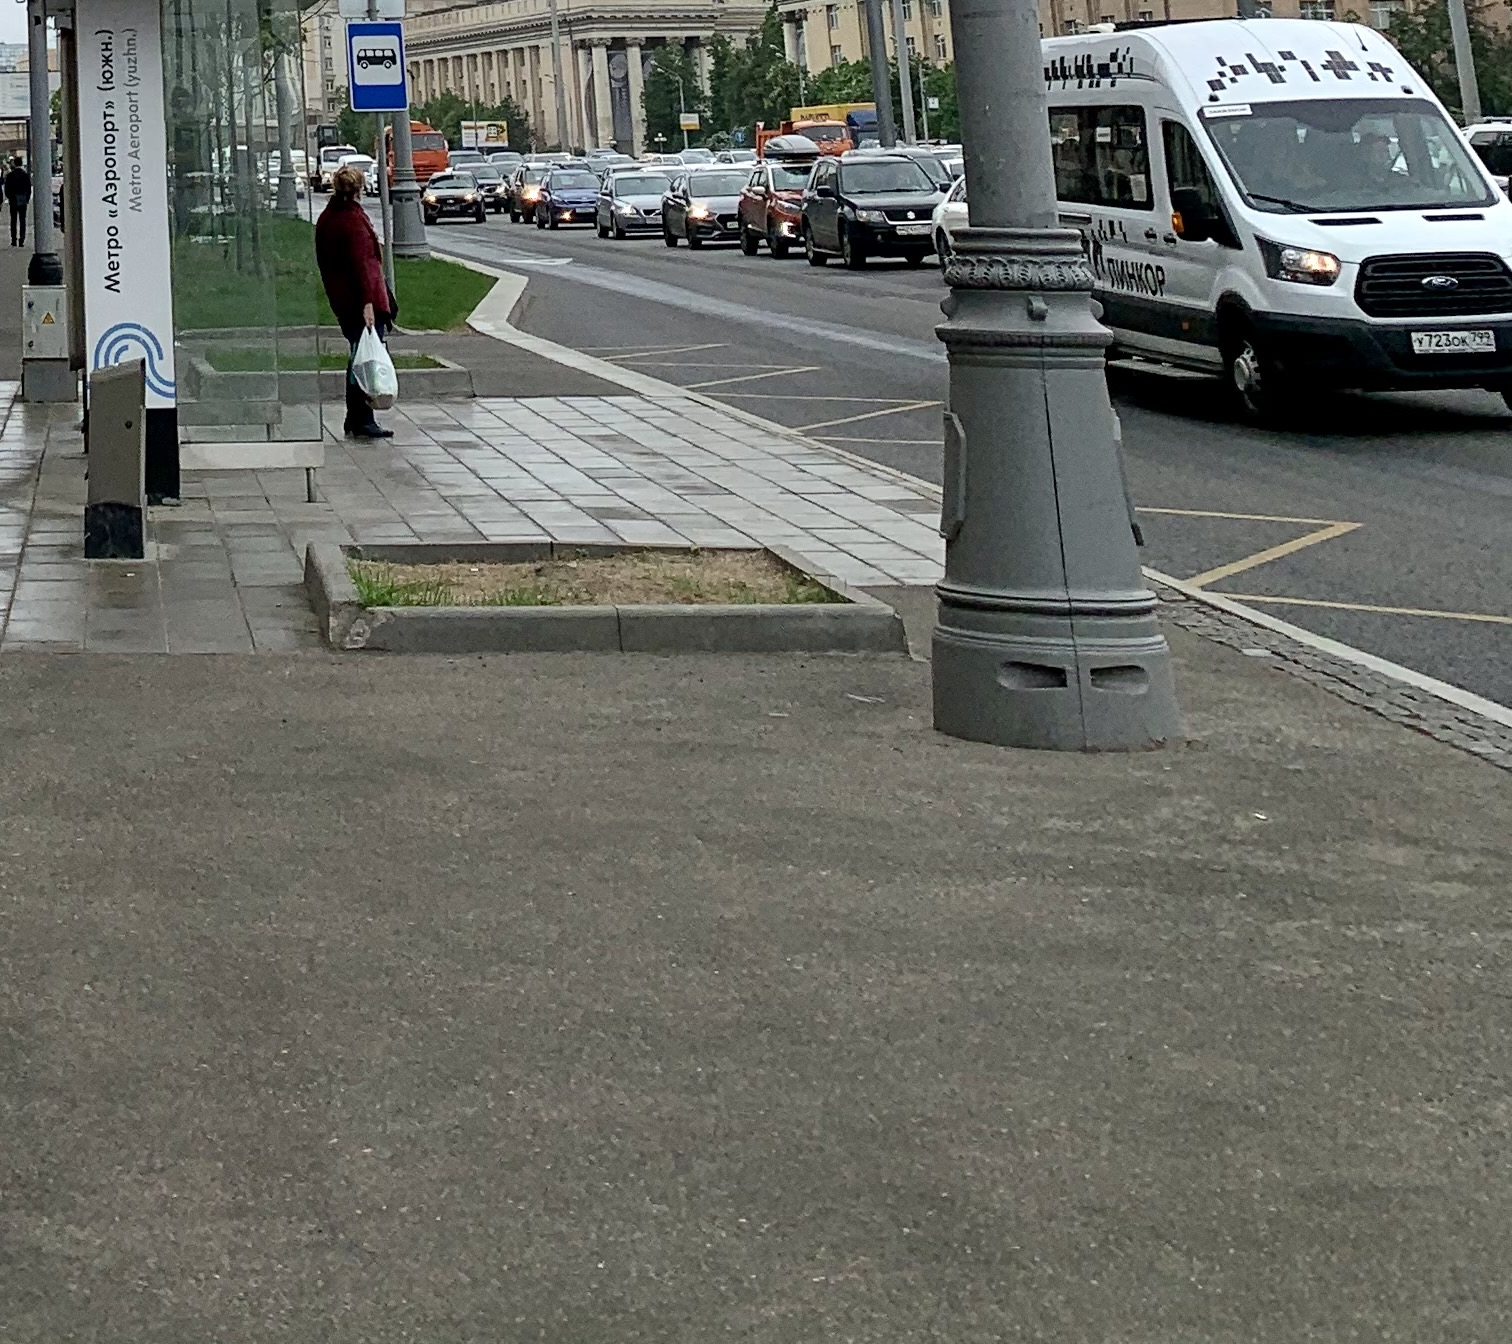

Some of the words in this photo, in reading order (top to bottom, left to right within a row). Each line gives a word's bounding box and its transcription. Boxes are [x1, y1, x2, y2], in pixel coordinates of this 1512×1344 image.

[95, 29, 115, 91] (южн.)
[121, 28, 141, 87] (yuzhn.)
[126, 91, 142, 161] Aeroport
[128, 164, 143, 213] Metro
[104, 225, 123, 294] Метро
